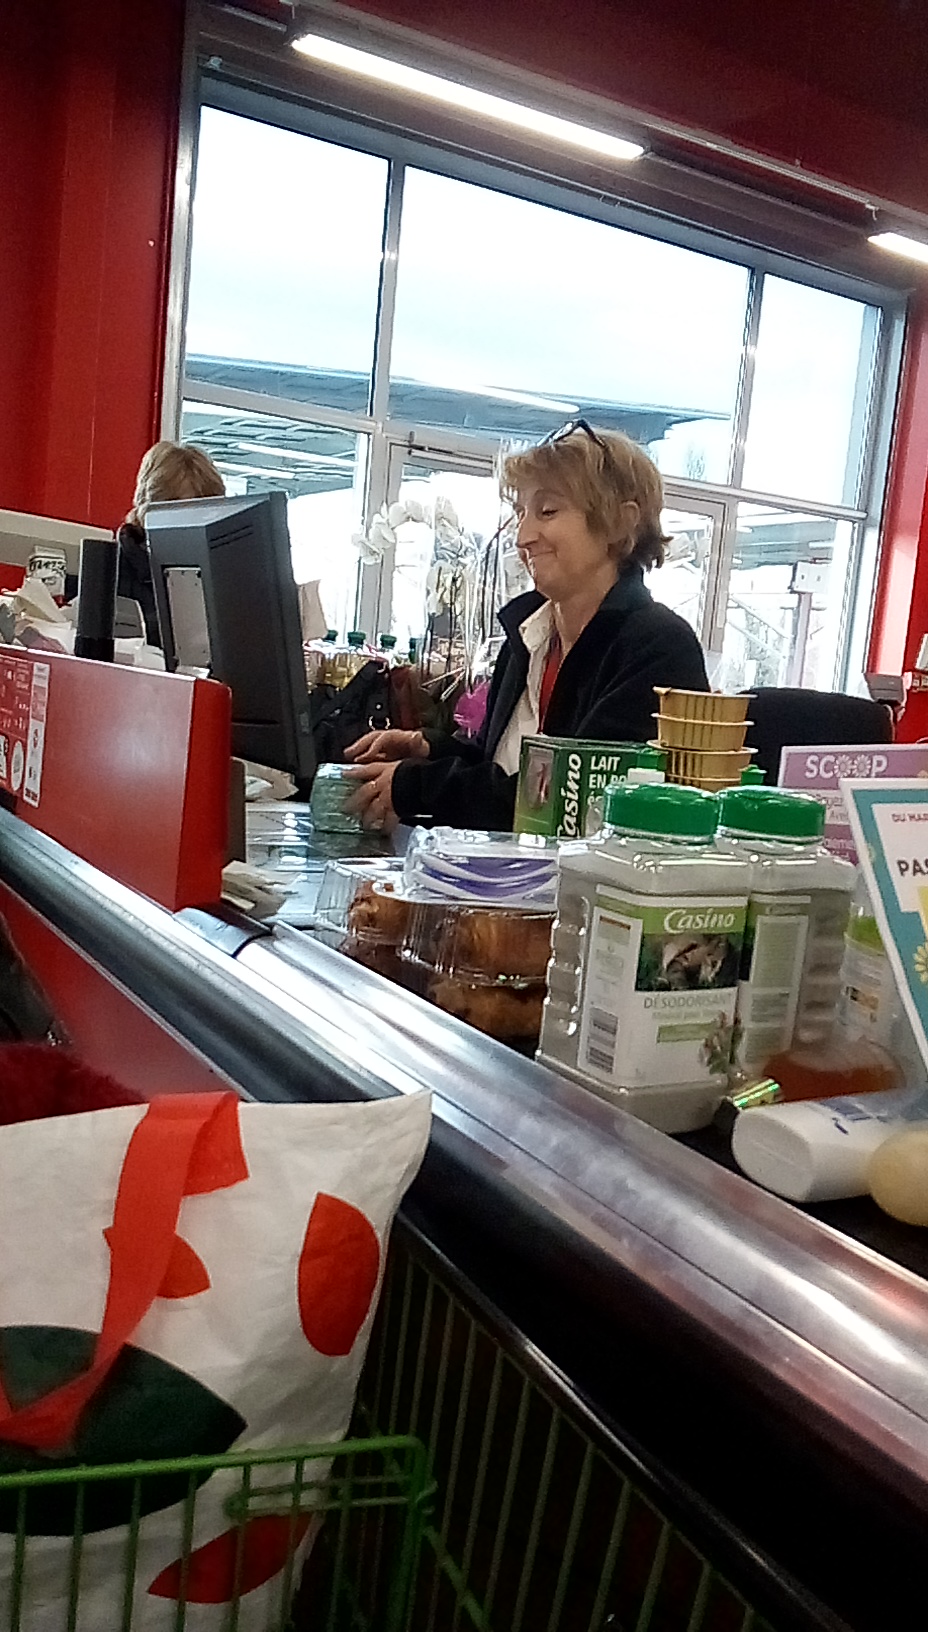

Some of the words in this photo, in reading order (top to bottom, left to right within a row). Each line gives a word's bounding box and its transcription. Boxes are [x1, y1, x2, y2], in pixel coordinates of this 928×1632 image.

[590, 755, 621, 772] LAIT
[805, 754, 888, 779] SCOOP
[588, 774, 606, 789] EN
[664, 908, 735, 933] Casino
